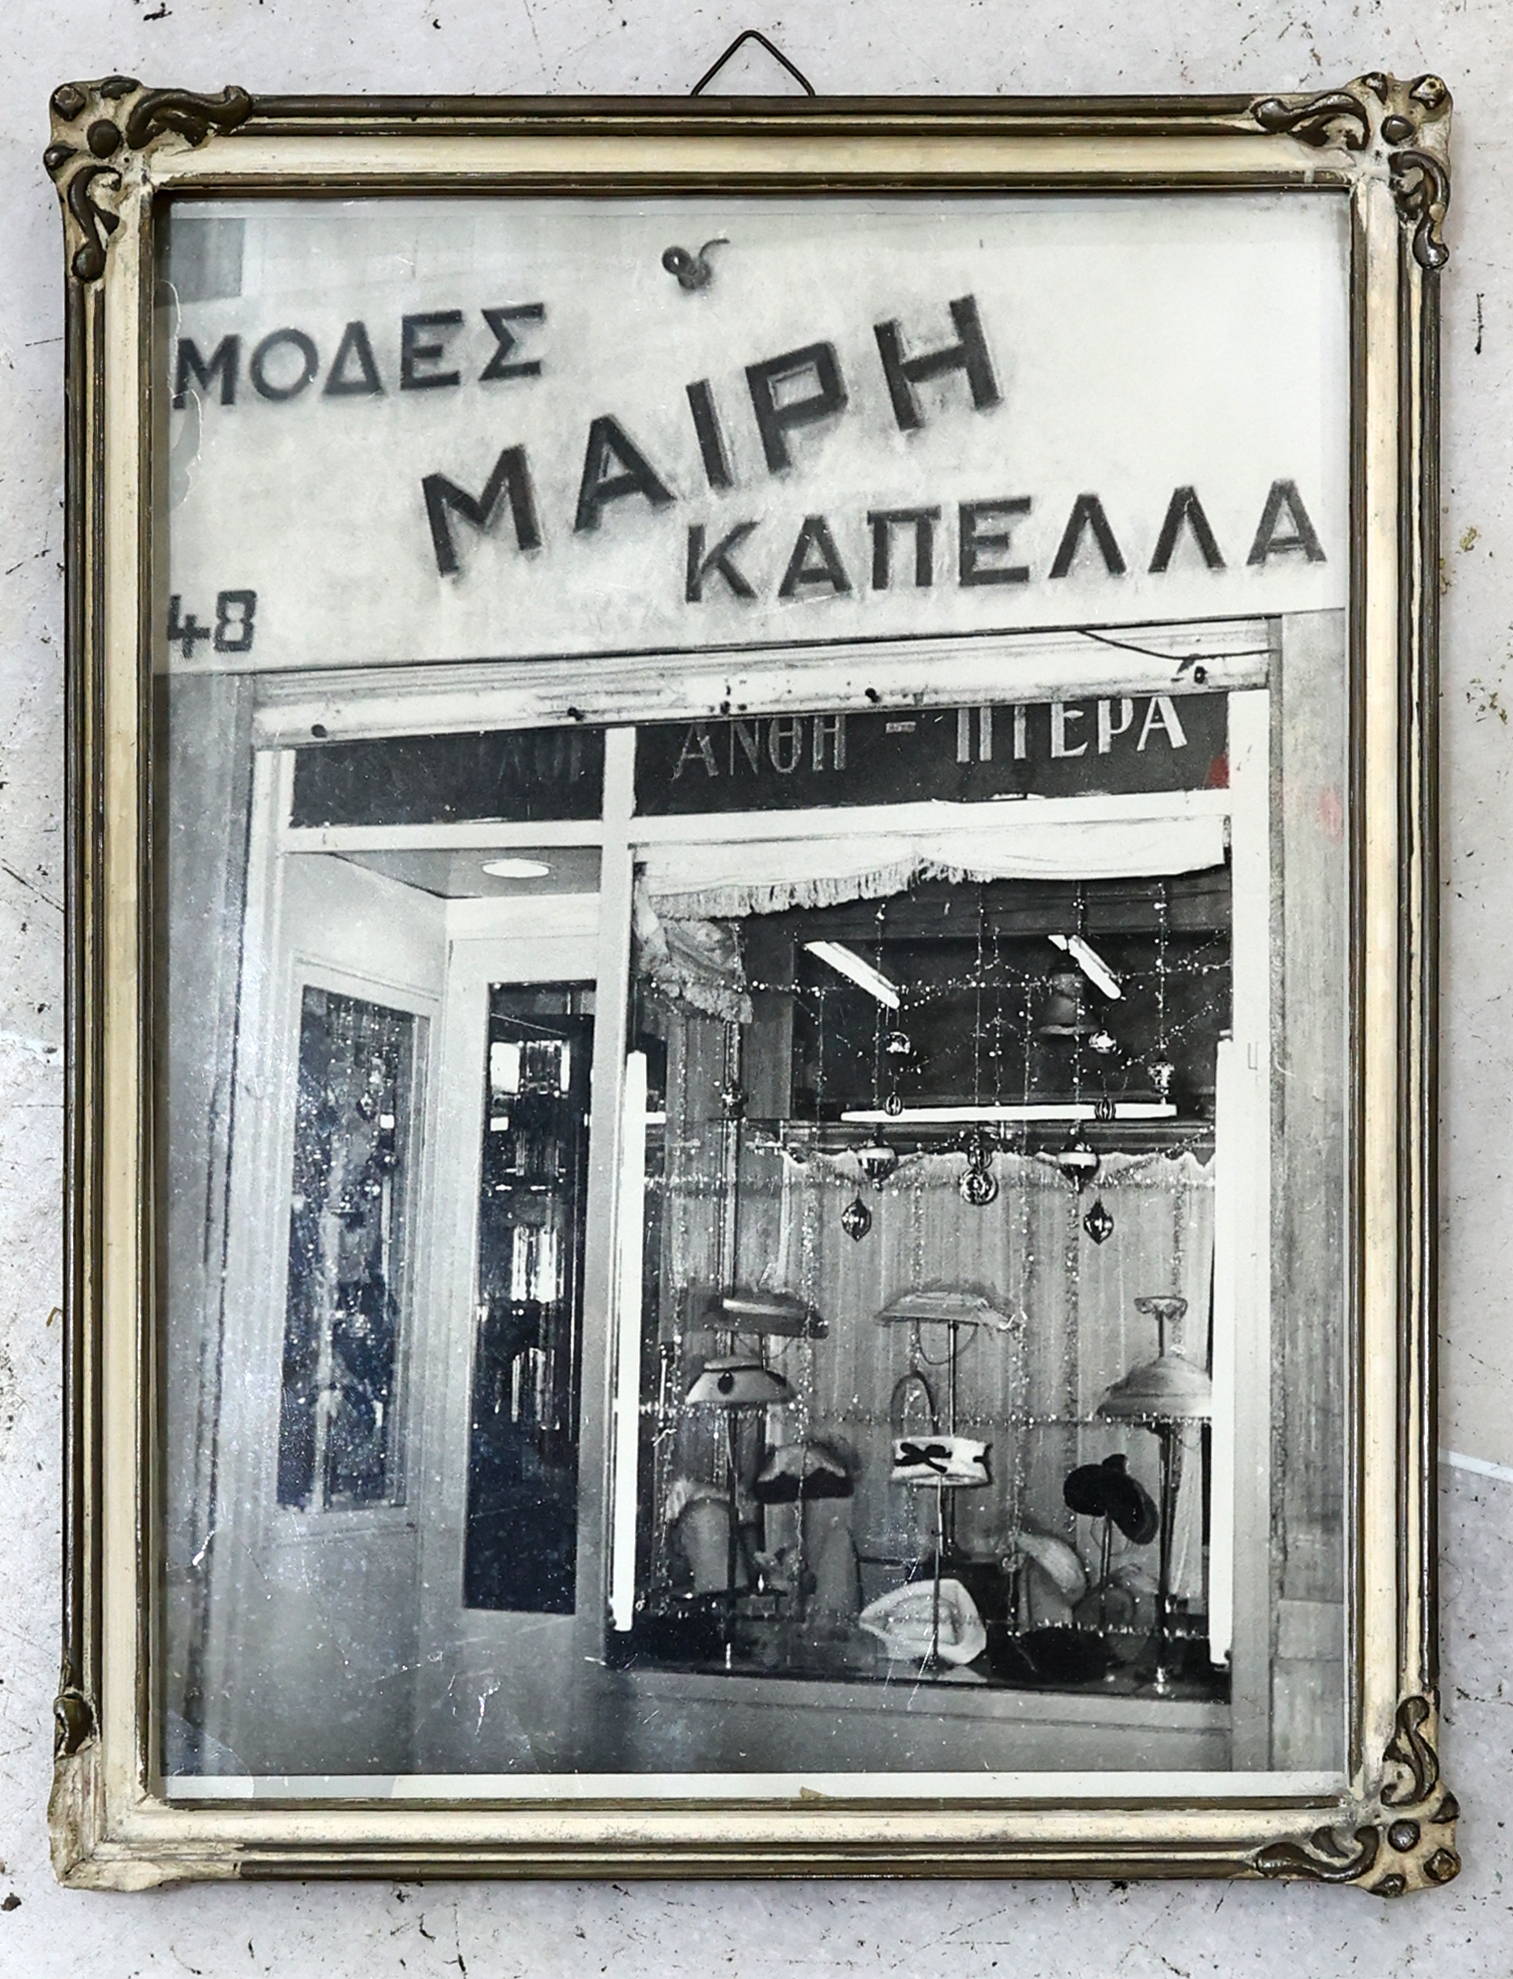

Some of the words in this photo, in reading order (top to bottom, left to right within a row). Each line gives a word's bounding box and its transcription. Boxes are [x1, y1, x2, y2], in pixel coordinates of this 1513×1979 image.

[169, 301, 547, 411] ΜΟΔΕΣ
[421, 293, 1004, 578] ΜΑΙΡΗ
[684, 478, 1328, 603] ΚΑΠΕΛΛΑ
[167, 589, 258, 659] 48
